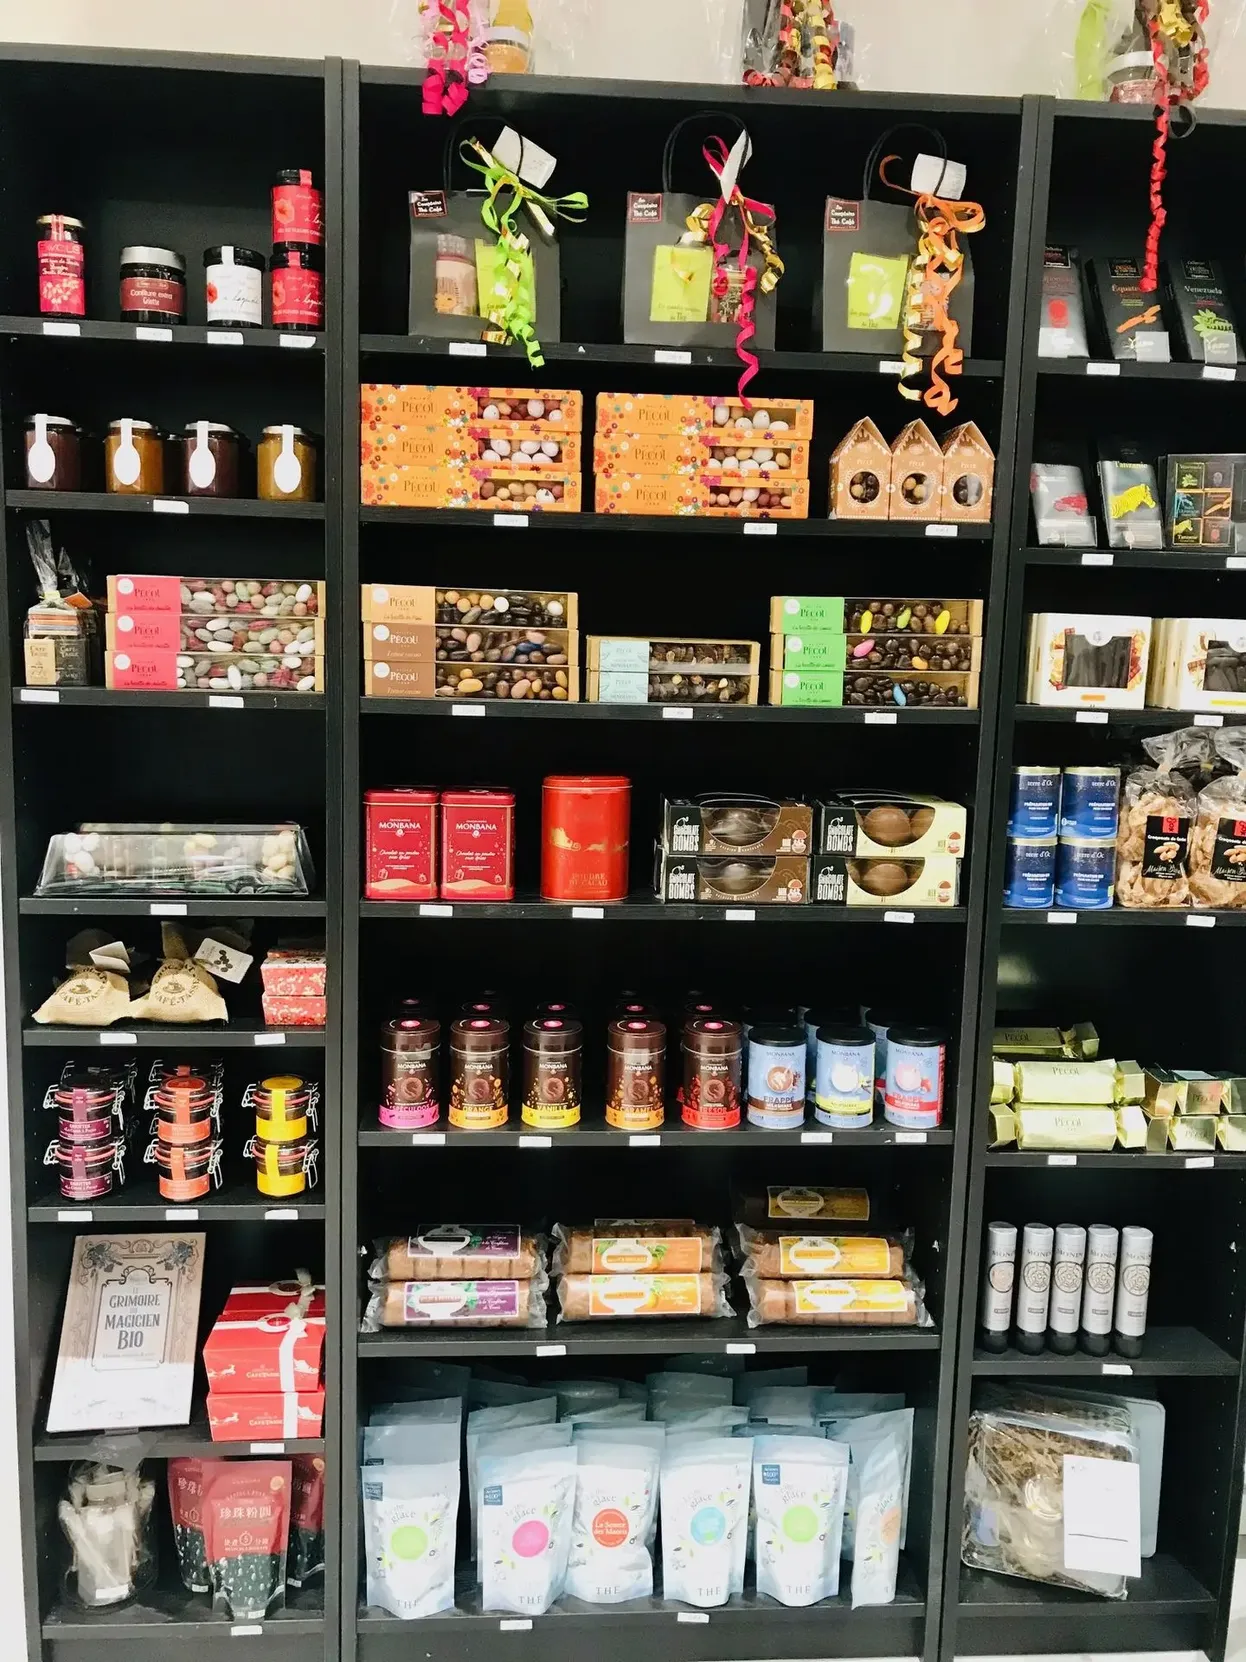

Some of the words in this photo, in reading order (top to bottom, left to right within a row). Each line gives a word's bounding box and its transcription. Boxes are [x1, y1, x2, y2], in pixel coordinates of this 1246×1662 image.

[130, 289, 157, 298] Confiture
[1184, 285, 1223, 295] Venezuela
[378, 821, 421, 830] MONBANA
[455, 823, 497, 831] MONBANA
[672, 834, 699, 852] BOMBS
[826, 835, 853, 852] BOMBS
[668, 883, 695, 900] BOMBS
[817, 884, 843, 900] BOMBS
[109, 1294, 161, 1309] GRIMOIRE
[104, 1313, 161, 1330] MAGICIEN
[117, 1330, 144, 1350] BIO
